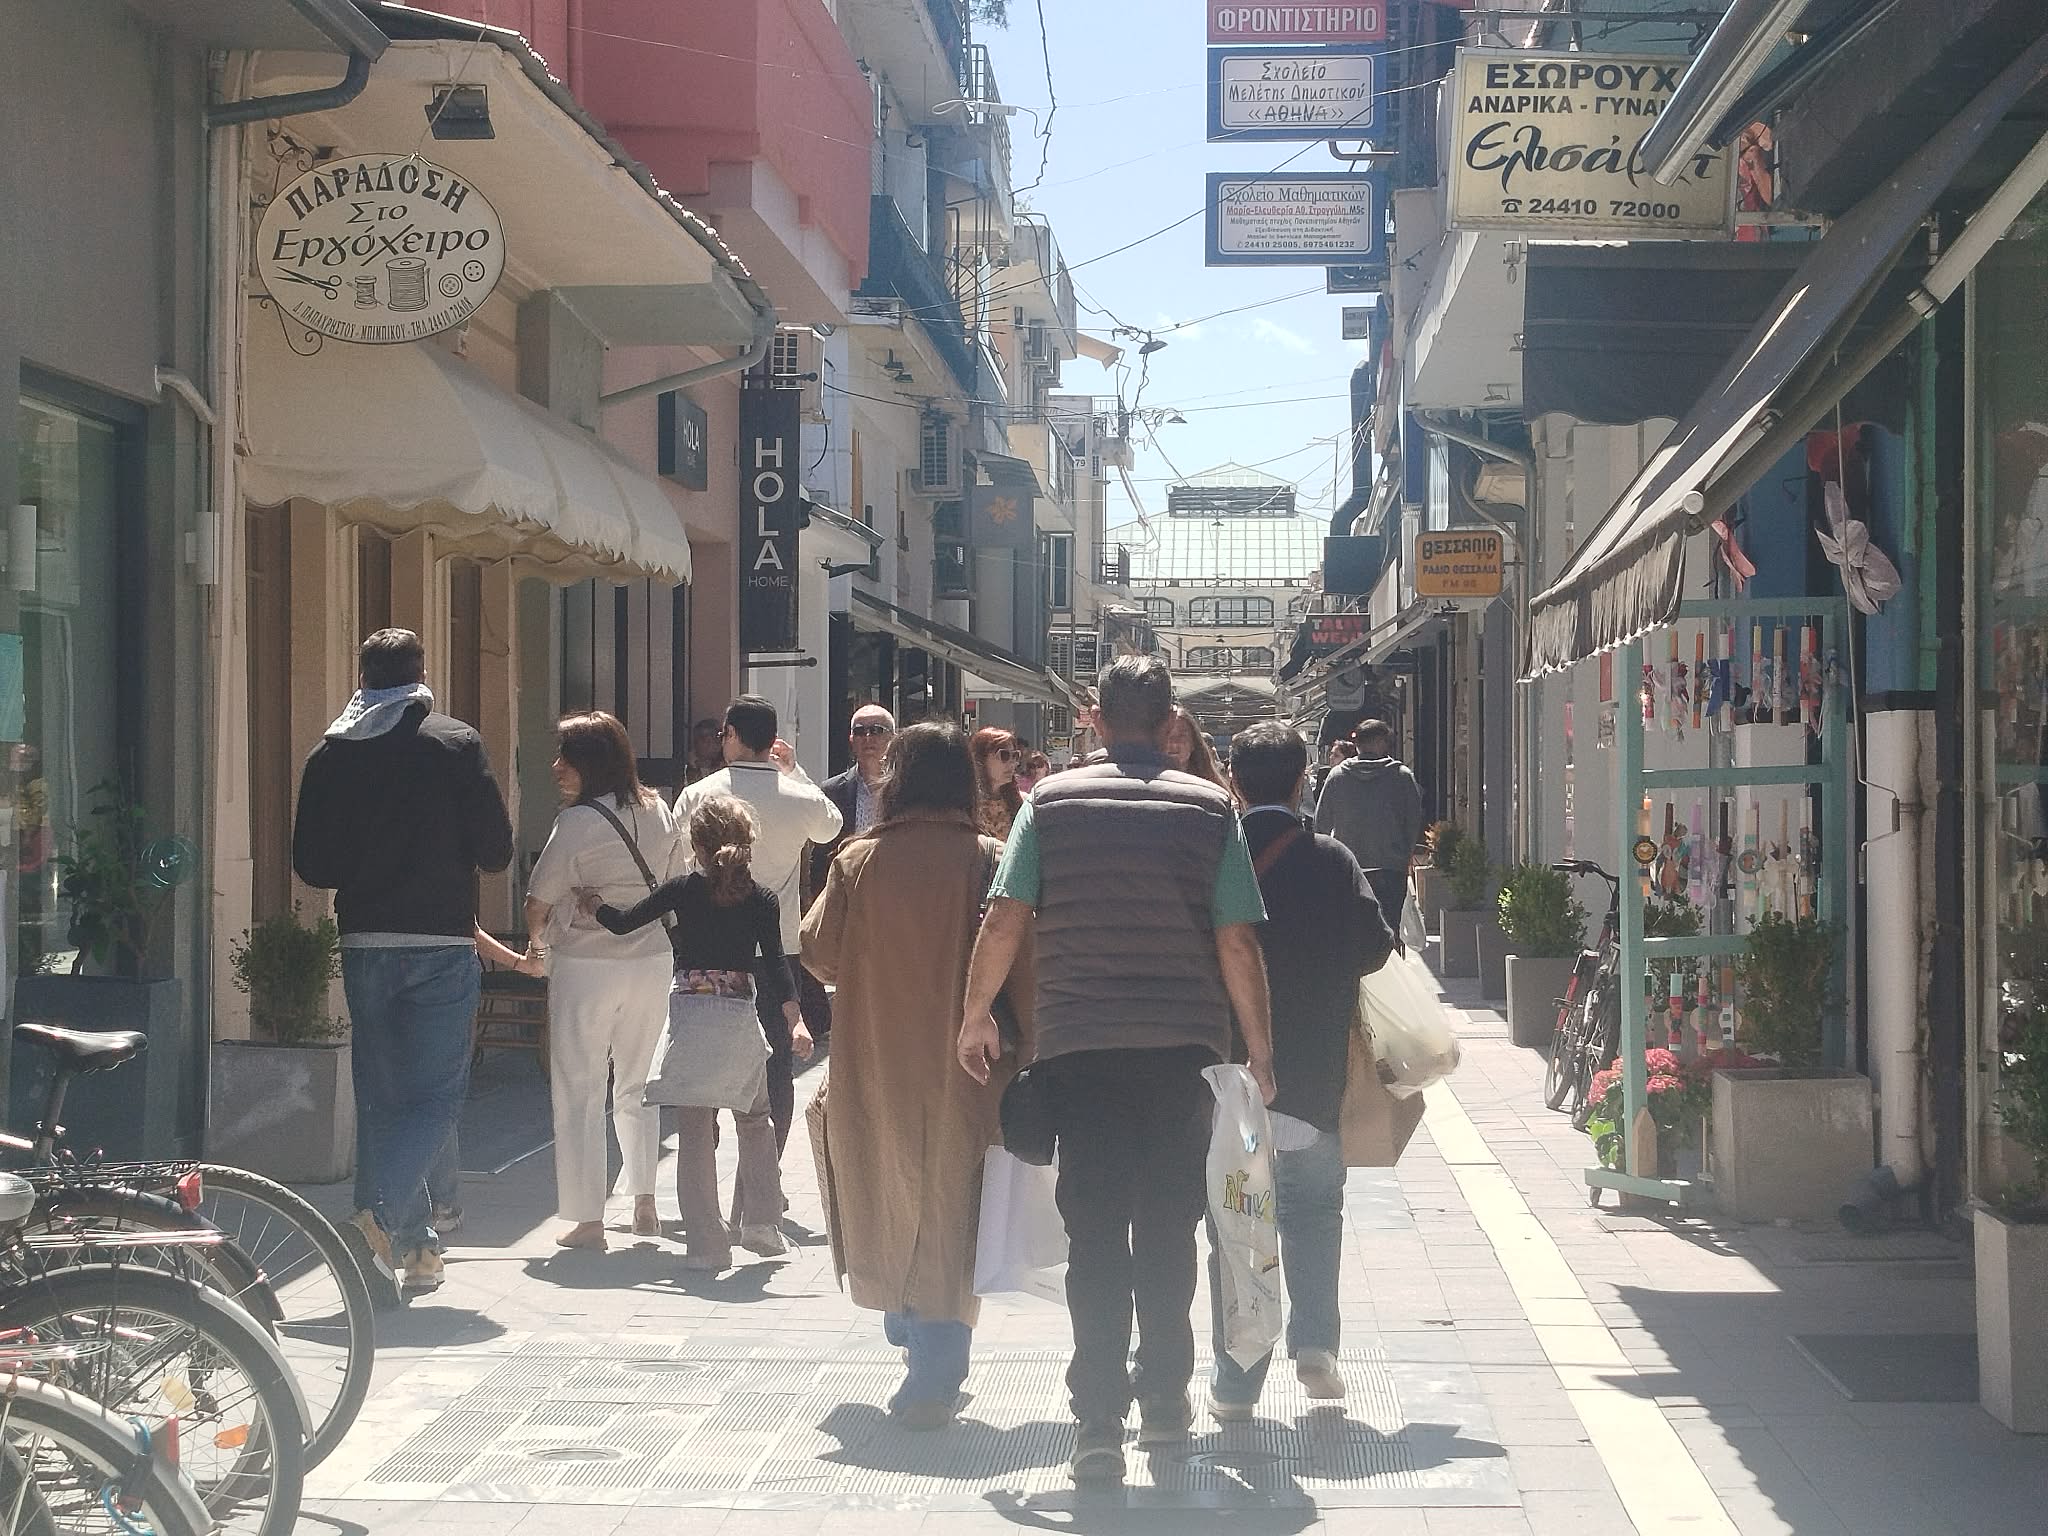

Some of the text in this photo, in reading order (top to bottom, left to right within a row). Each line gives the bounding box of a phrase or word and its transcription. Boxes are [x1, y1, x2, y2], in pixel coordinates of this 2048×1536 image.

[1217, 7, 1377, 32] ΦΡΟΝΤΙΣΤΗΡΙΟ
[1261, 60, 1326, 80] Σχολείο
[1485, 63, 1680, 93] ΕΣΩΡΟΥΧ
[1229, 82, 1366, 101] Μελέτης Δημοτικού
[1467, 95, 1573, 114] ΑΝΔΡΙΚΑ
[1594, 96, 1667, 116] ΓΥΝΑΙ
[285, 161, 470, 221] ΠΑΡΑΔΟΣΗ
[1226, 185, 1365, 205] Σχολείο Μαθηματικών
[346, 200, 408, 224] Στο
[1527, 198, 1681, 219] 24410 72000
[271, 224, 490, 267] Εργόχειρο
[360, 324, 406, 340] ΜΠΙΜΠΙΚΟΥ
[683, 416, 701, 454] HOLA
[753, 437, 785, 570] HOLA
[748, 575, 789, 588] HOME
